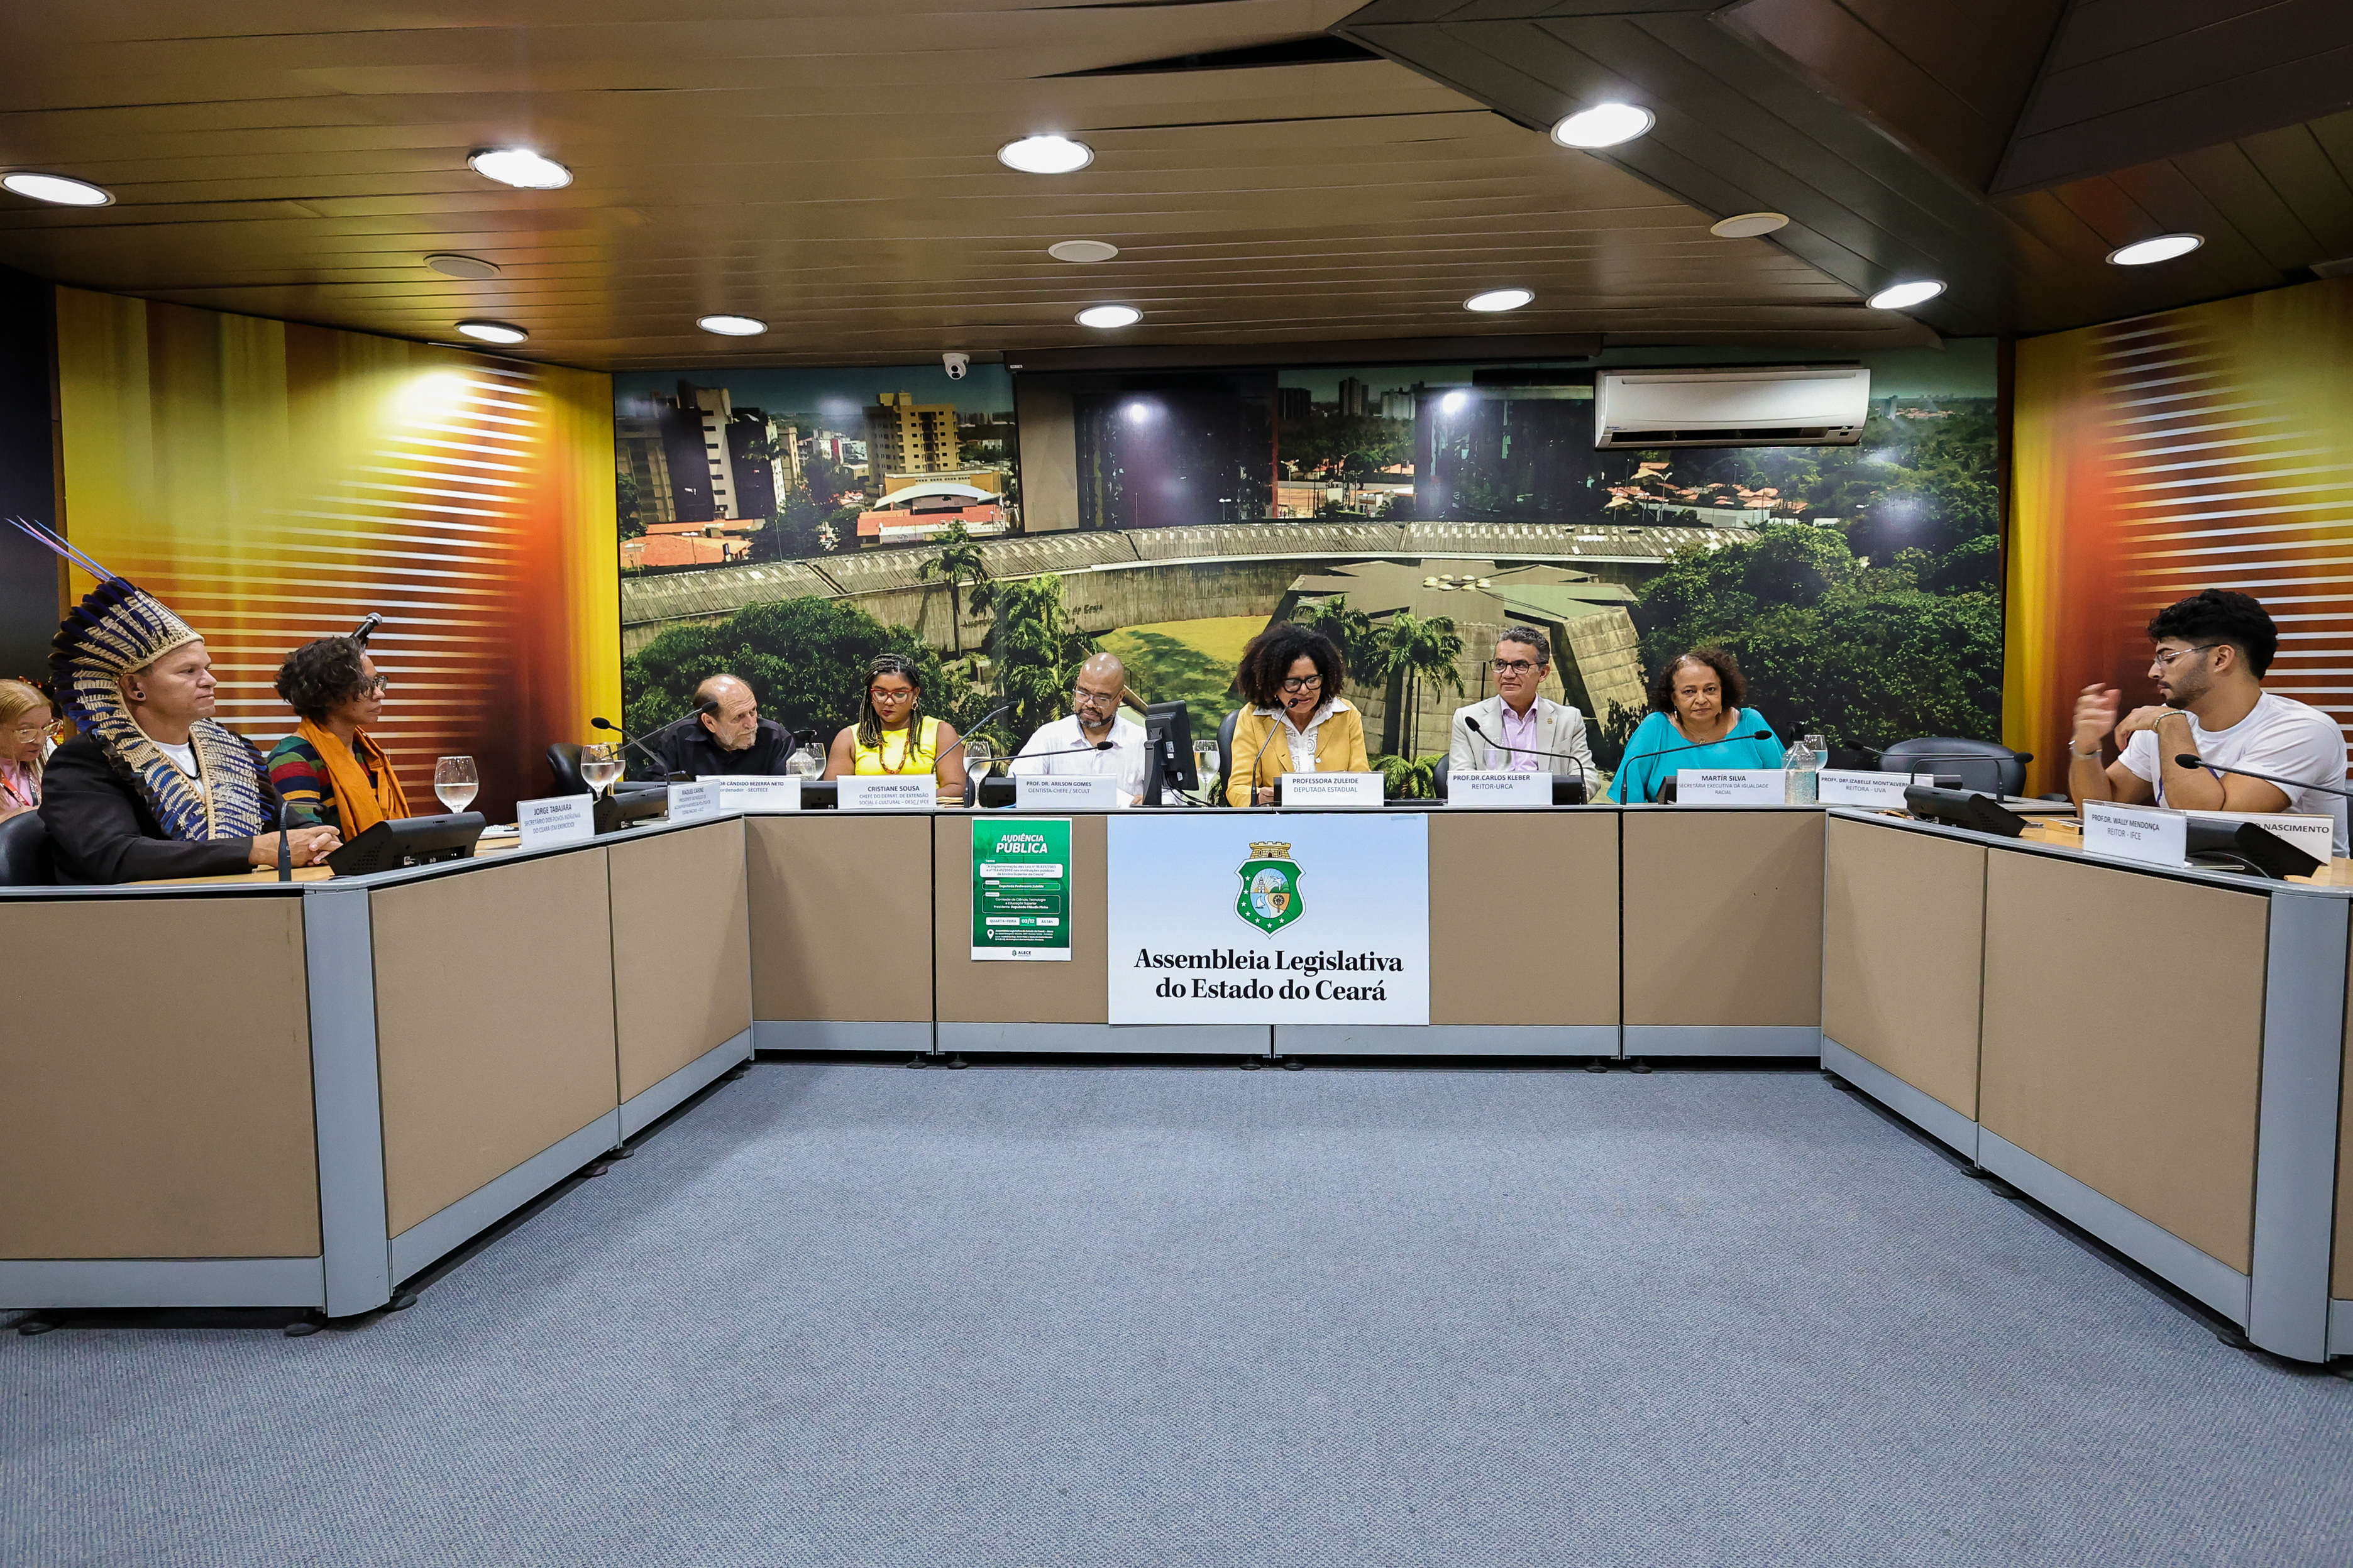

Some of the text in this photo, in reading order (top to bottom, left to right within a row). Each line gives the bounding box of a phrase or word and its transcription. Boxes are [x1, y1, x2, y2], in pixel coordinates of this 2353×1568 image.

[534, 803, 572, 816] JORGE TABAJARA
[524, 818, 546, 827] SECRETÁRIO
[2092, 814, 2160, 832] PROF.DR. WALLY MENDONÇA
[2264, 823, 2330, 833] NASCIMENTO
[1001, 833, 1044, 842] AUDIÊNCIA
[2107, 827, 2125, 837] REITOR
[2130, 831, 2141, 840] IFCE
[996, 841, 1048, 853] PÚBLICA
[1134, 948, 1404, 977] Assembleia Legislativa
[1155, 977, 1387, 1001] do Estado do Ceará
